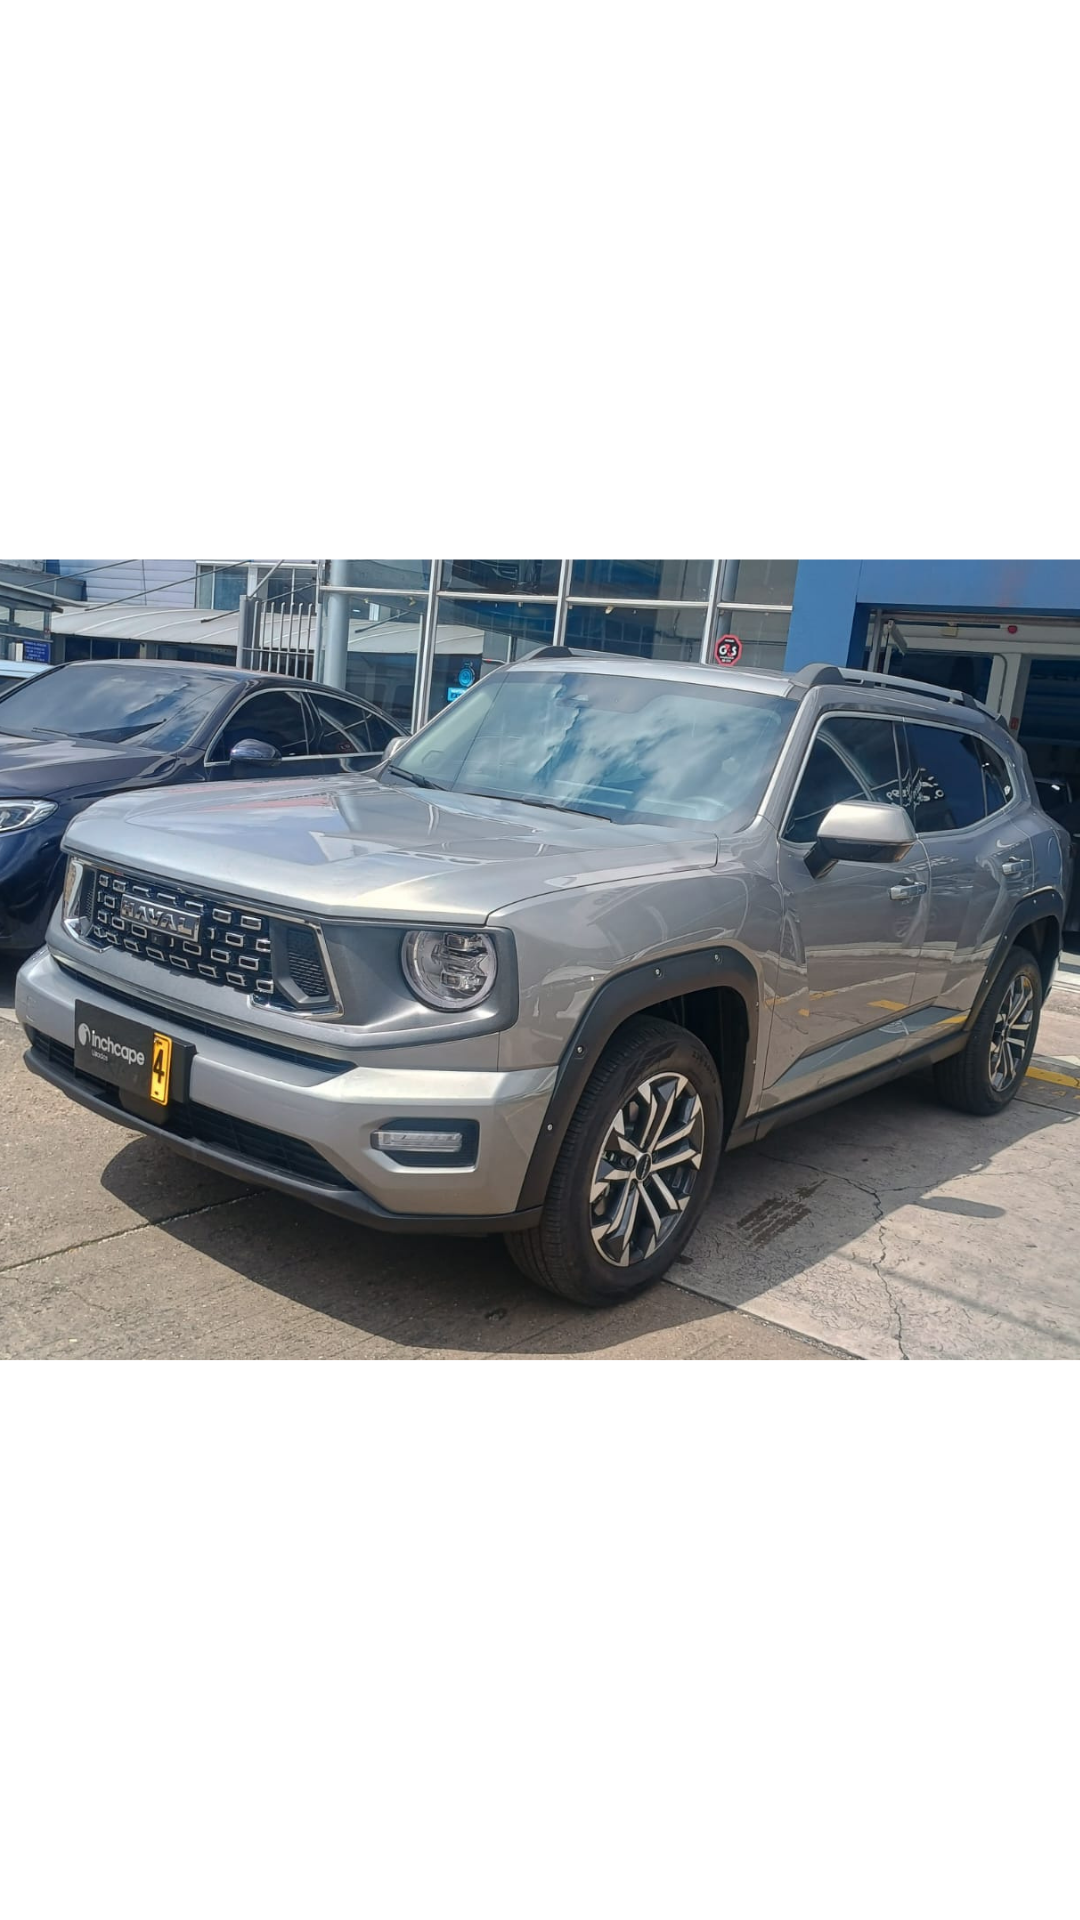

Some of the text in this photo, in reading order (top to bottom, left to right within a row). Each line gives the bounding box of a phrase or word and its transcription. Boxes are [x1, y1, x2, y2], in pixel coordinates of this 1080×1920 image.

[121, 900, 193, 935] HAVAL
[91, 1030, 145, 1065] inchcape
[153, 1049, 165, 1084] 4
